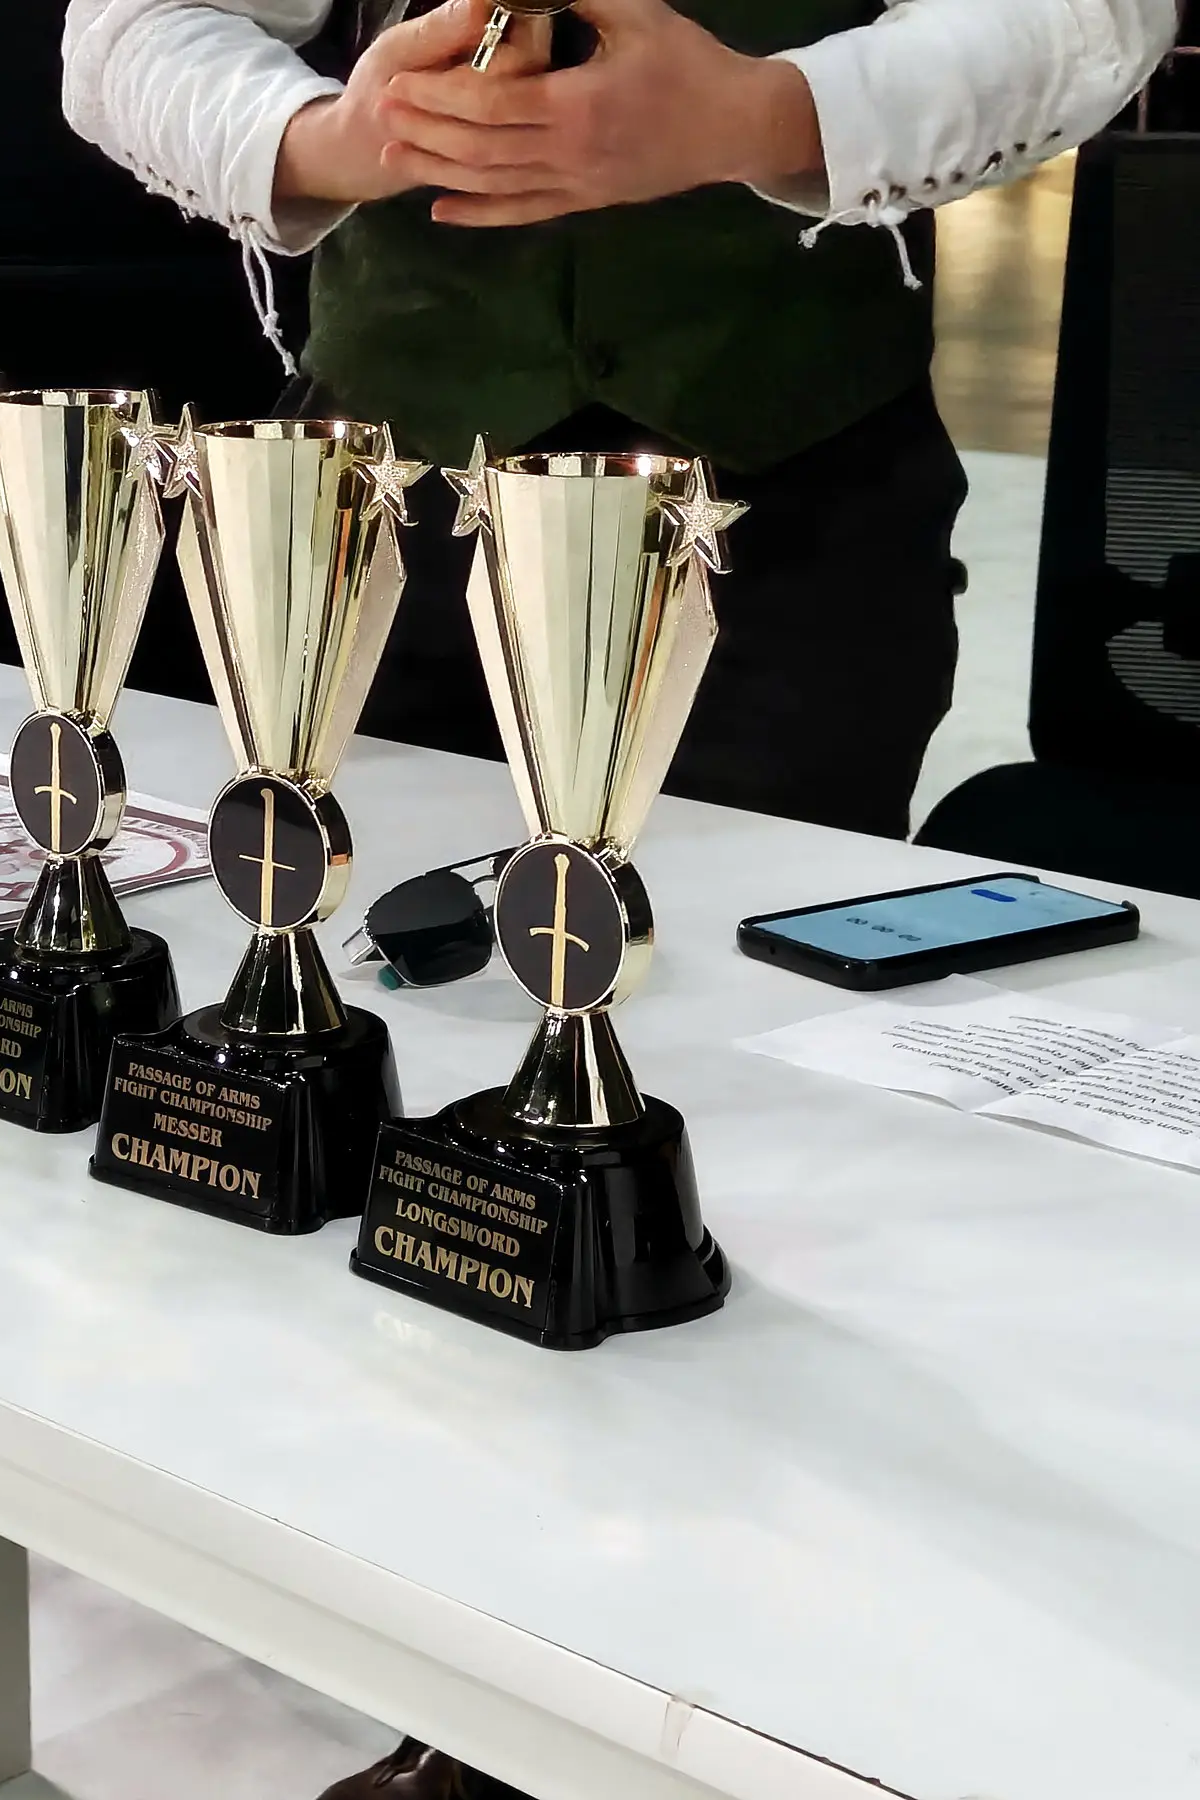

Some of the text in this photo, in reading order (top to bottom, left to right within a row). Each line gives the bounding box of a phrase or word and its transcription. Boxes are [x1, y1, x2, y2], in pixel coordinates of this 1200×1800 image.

[0, 997, 34, 1019] ARMS
[113, 1076, 273, 1132] FIGHT CHAMPIONSHIP
[128, 1062, 261, 1110] PASSAGE OF ARMS
[152, 1112, 223, 1148] MESSER
[1157, 1122, 1193, 1135] Sam
[111, 1132, 262, 1199] CHAMPION
[394, 1150, 537, 1211] PASSAGE OF ARMS
[378, 1164, 548, 1235] FIGHT CHAMPIONSHIP
[395, 1197, 521, 1258] LONGSWORD
[374, 1225, 536, 1309] CHAMPION
